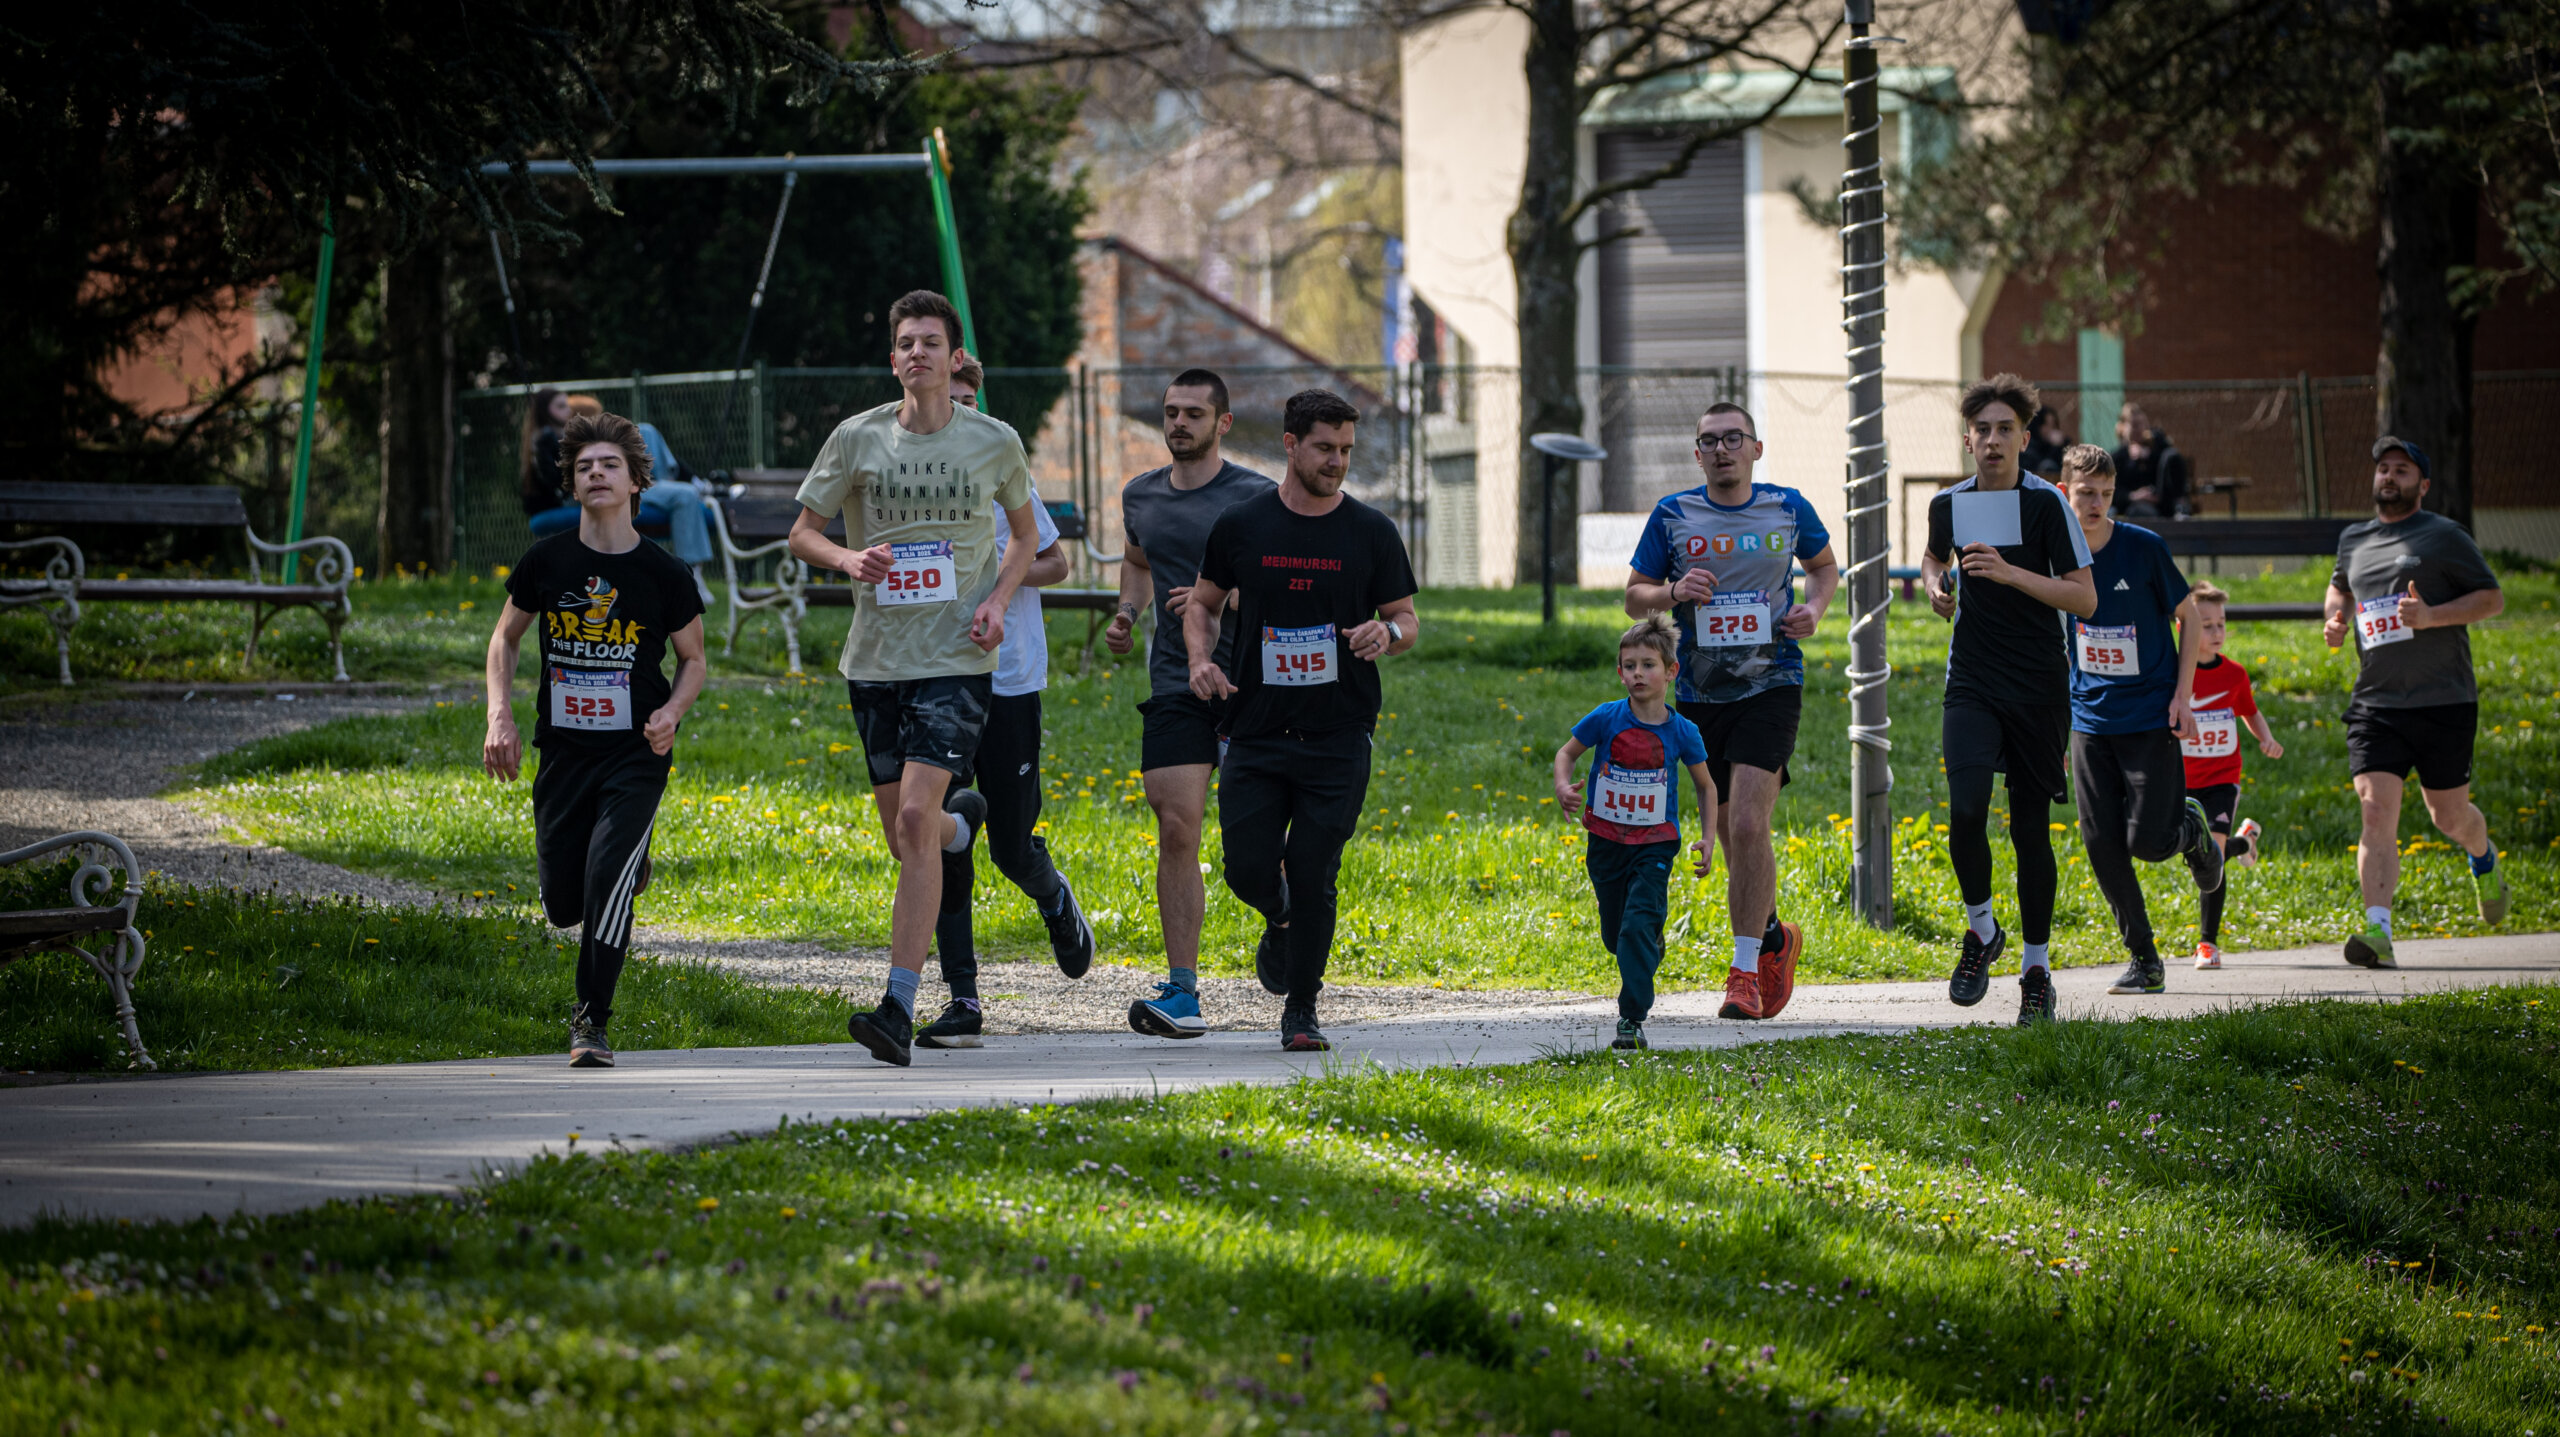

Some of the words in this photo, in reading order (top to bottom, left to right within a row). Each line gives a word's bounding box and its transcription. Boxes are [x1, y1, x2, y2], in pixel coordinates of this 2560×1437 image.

[900, 463, 947, 475] NIKE
[875, 485, 971, 498] RUNNING
[876, 509, 971, 521] DIVISION
[887, 568, 942, 591] 520
[1288, 578, 1313, 591] ZET
[546, 611, 647, 645] BREAK
[1709, 614, 1759, 634] 278
[2366, 615, 2401, 636] 391
[551, 638, 571, 651] THE
[573, 641, 637, 661] FLOOR
[2086, 646, 2125, 665] 553
[1276, 651, 1326, 673] 145
[565, 695, 615, 717] 523
[1605, 790, 1655, 812] 144
